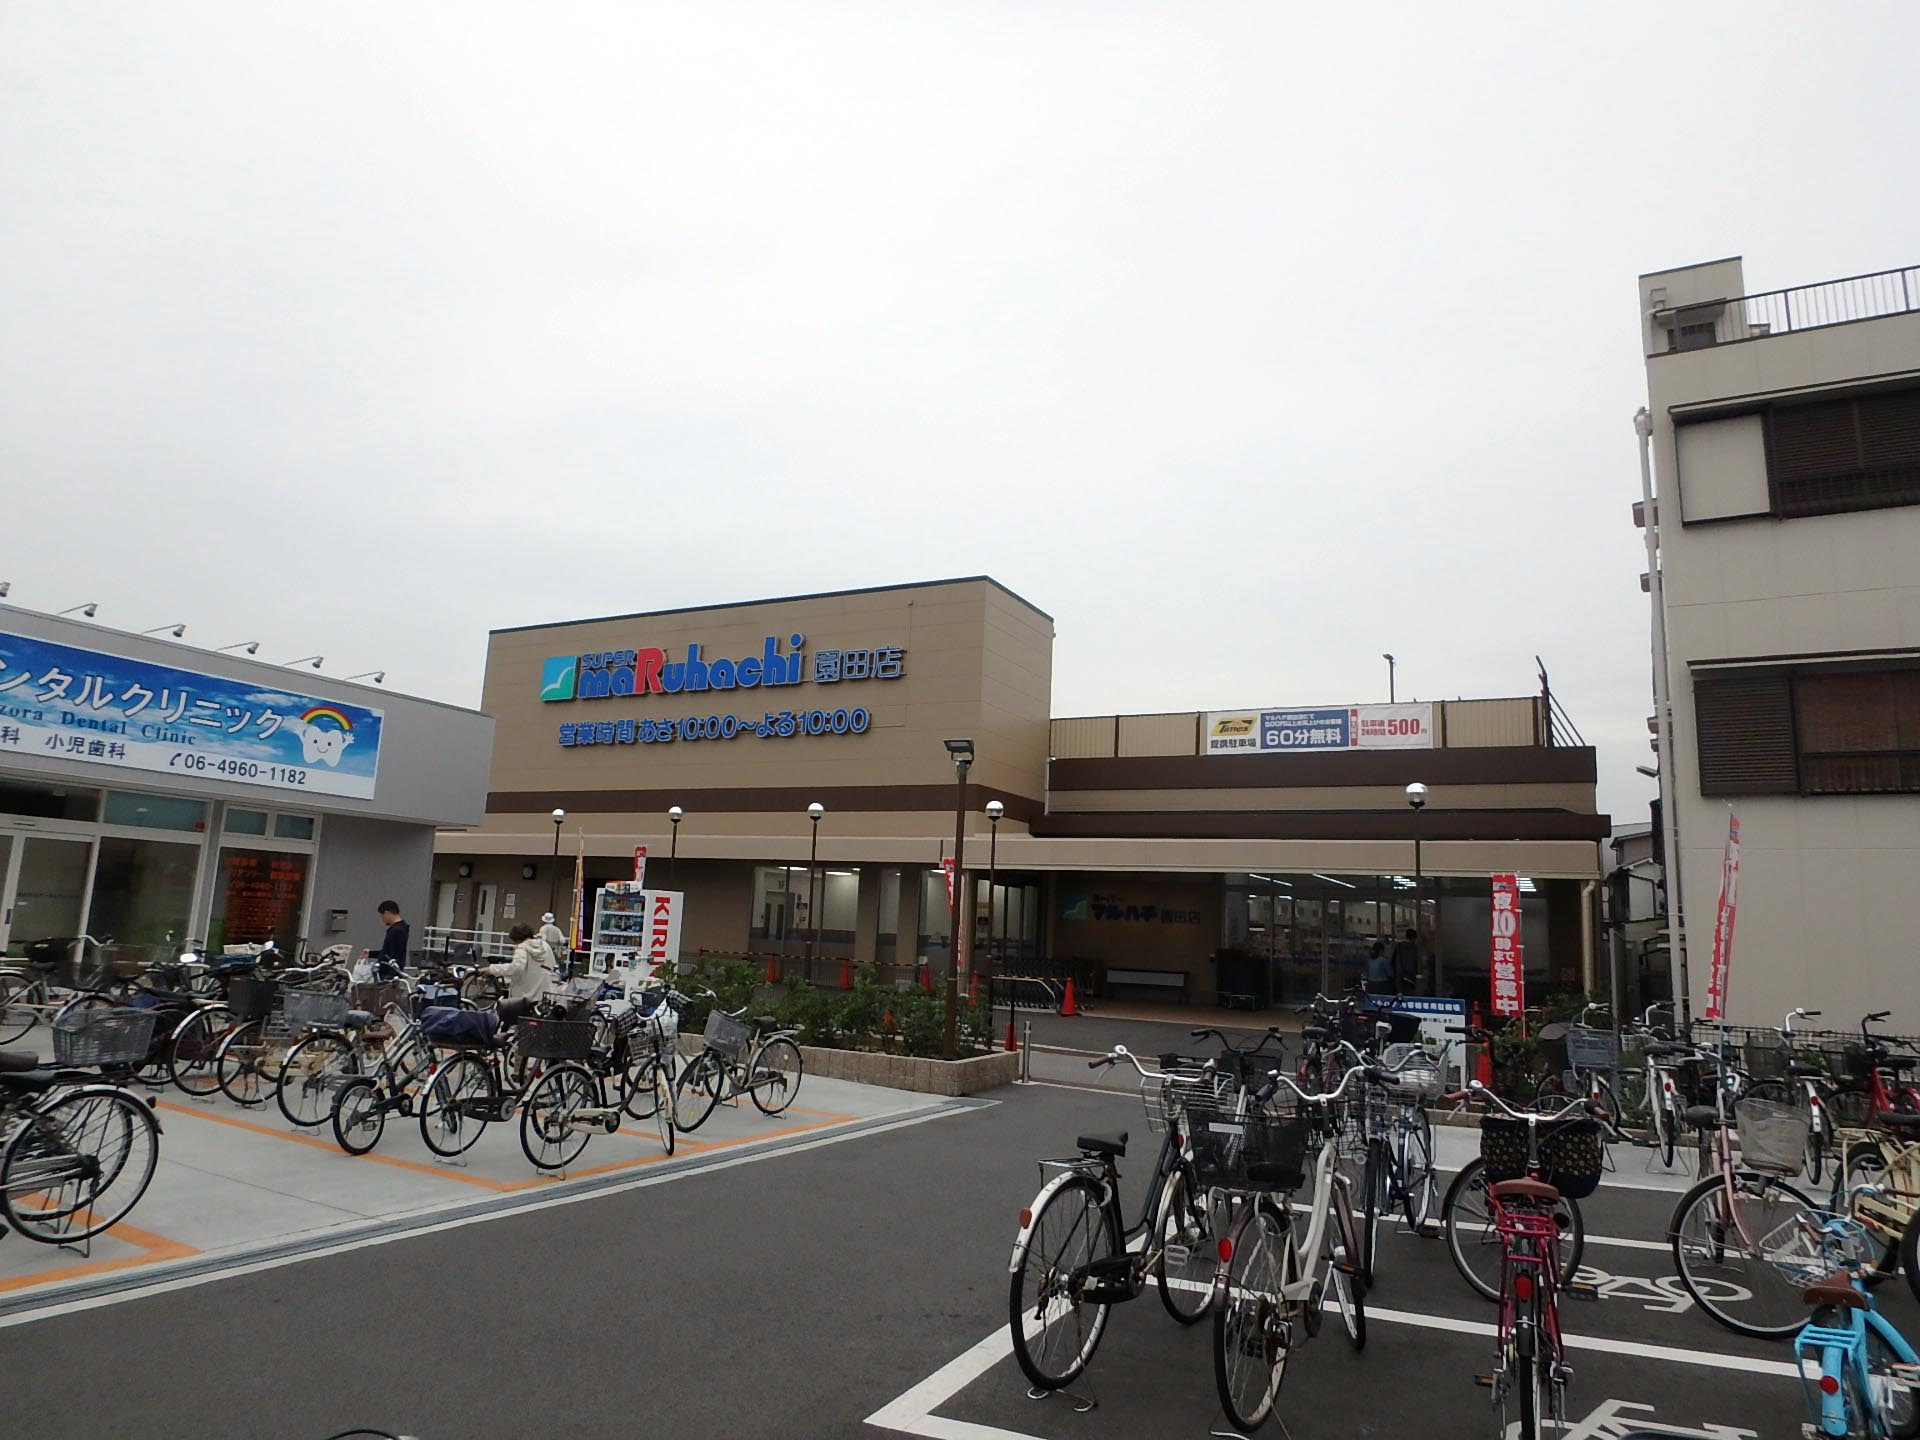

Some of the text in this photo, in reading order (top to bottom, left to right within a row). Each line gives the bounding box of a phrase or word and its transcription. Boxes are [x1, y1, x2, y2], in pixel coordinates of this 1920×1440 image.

[581, 648, 636, 669] SUPER
[813, 646, 904, 683] 園田店
[0, 656, 284, 740] ンタルクリニック
[61, 710, 128, 735] Dental
[141, 722, 197, 747] Clinic
[559, 719, 635, 747] 営業時間
[1265, 727, 1341, 745] 60分無料
[45, 733, 126, 760] 小児歯科
[184, 753, 307, 784] 06-4960-1182
